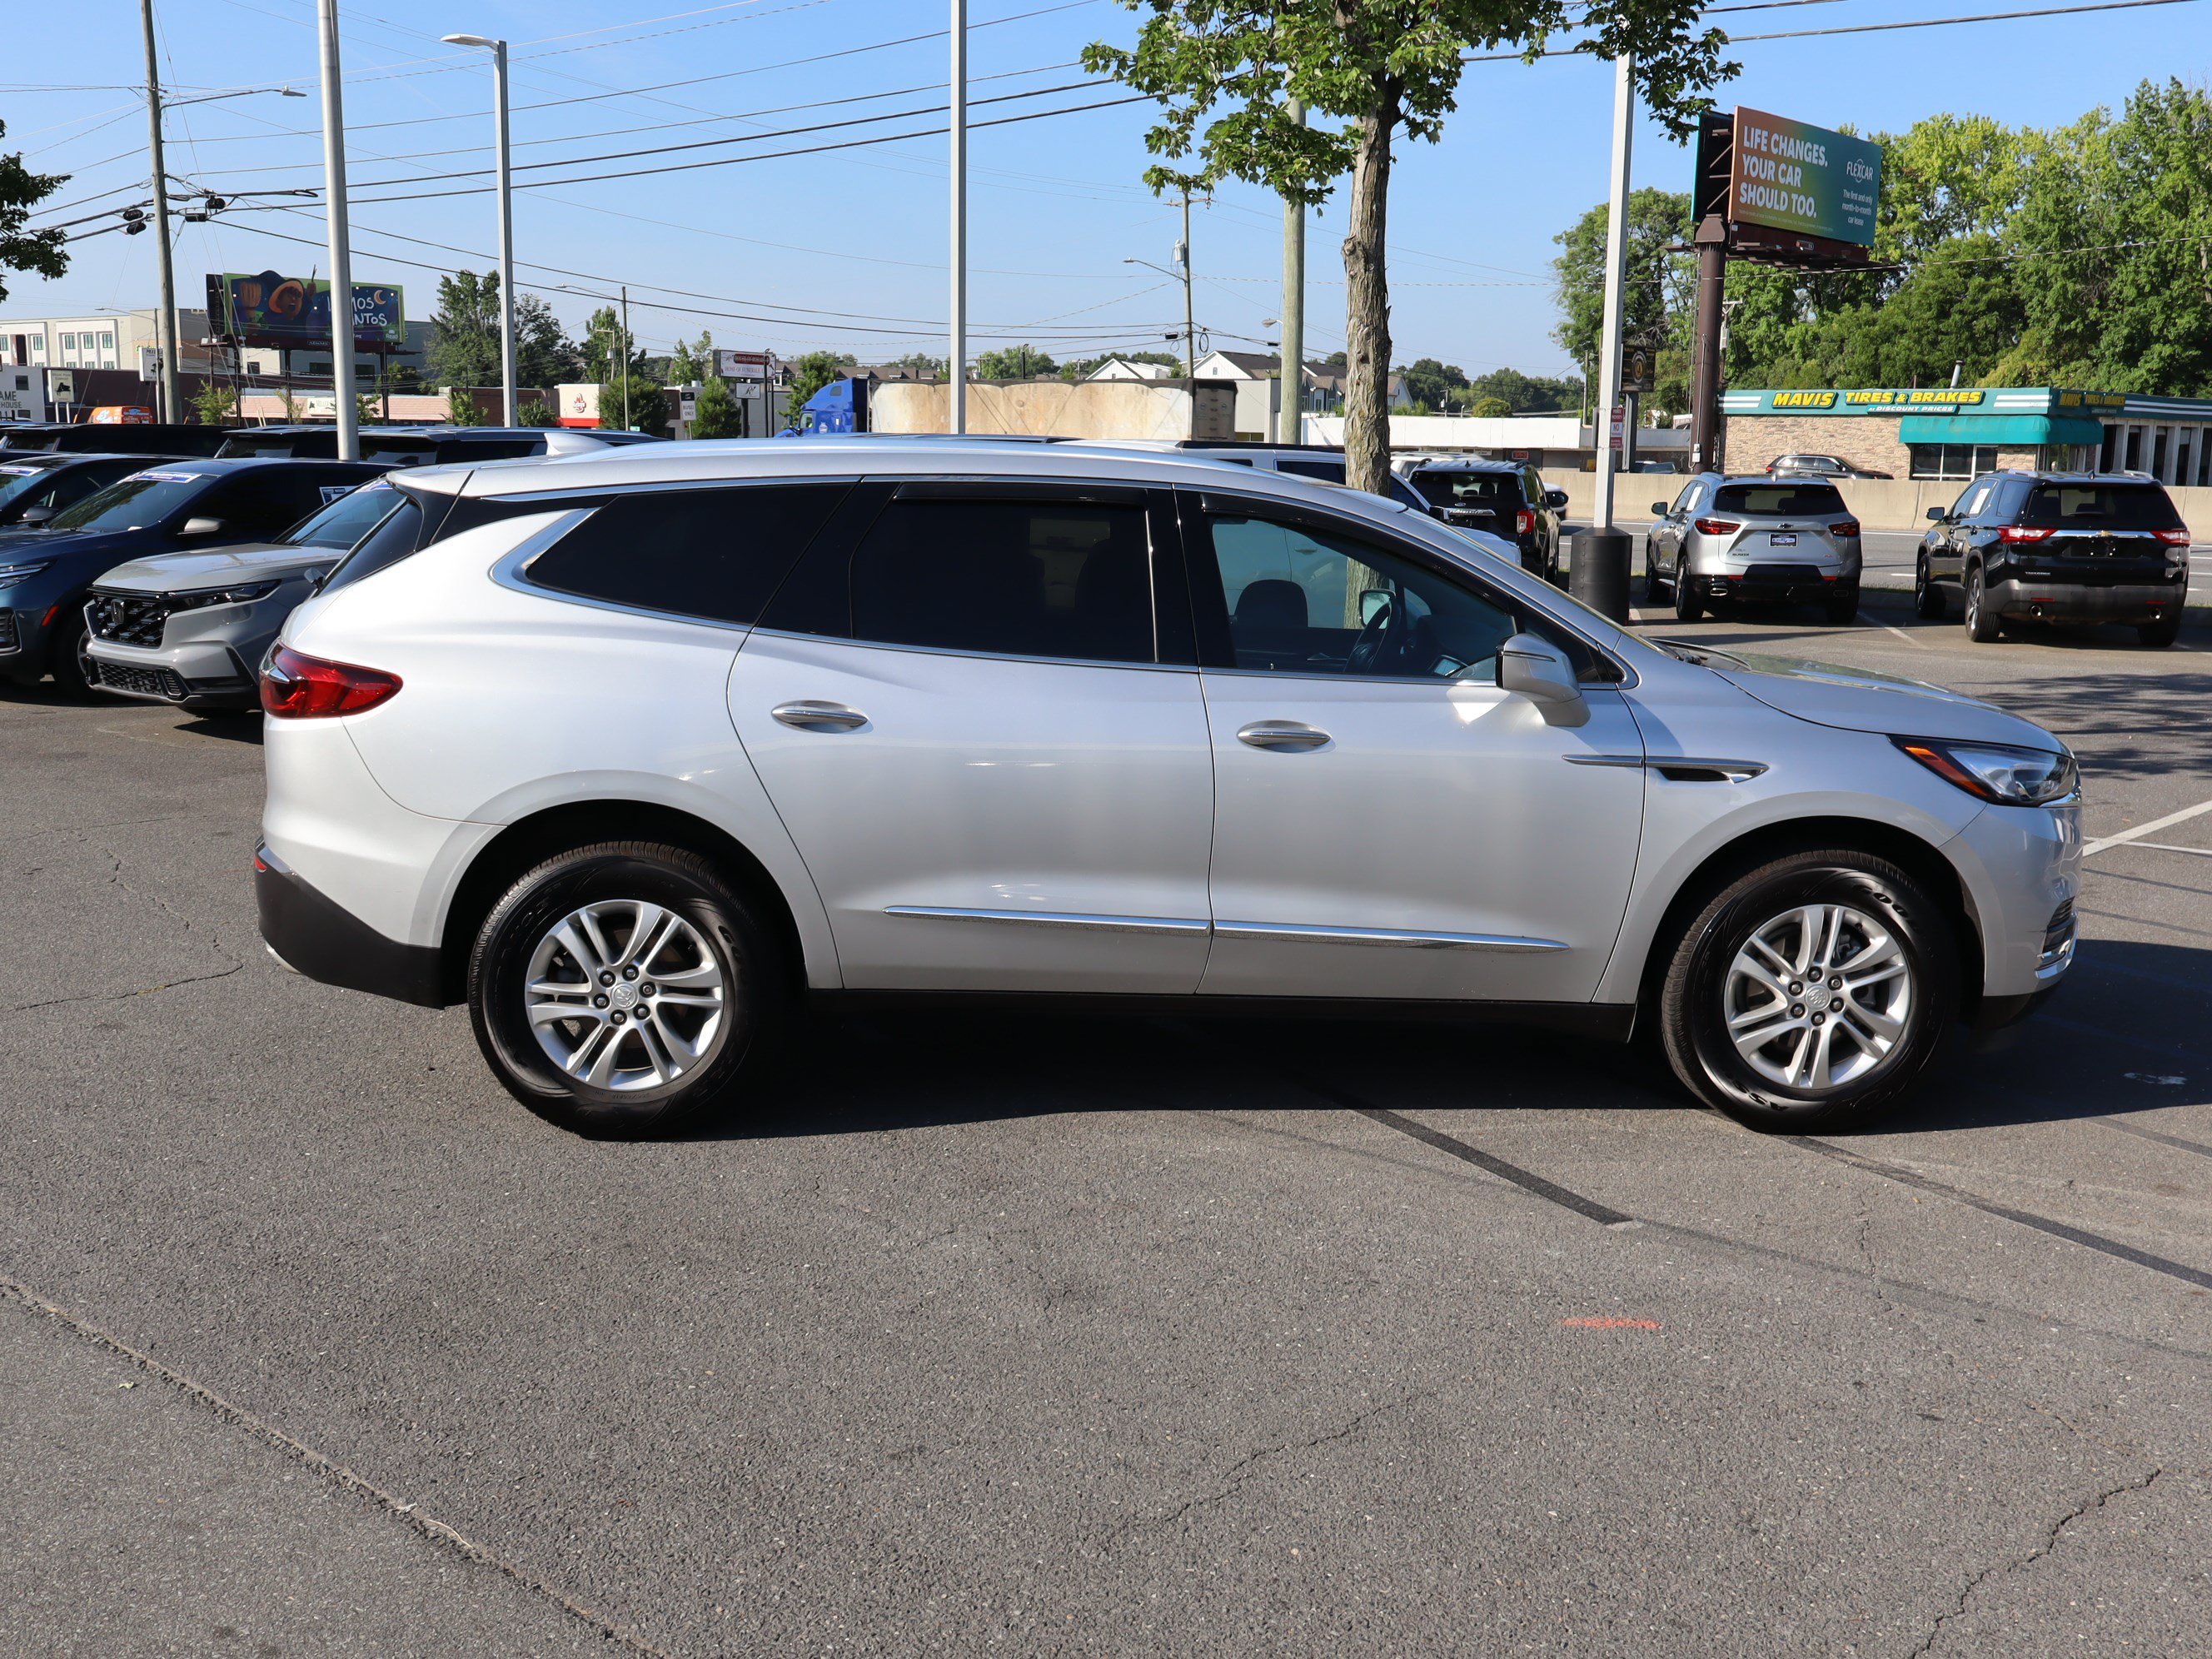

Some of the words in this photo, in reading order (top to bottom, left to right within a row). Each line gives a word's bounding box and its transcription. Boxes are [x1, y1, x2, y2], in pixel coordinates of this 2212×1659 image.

[1743, 125, 1768, 150] LIFE
[1771, 132, 1828, 167] CHANGES.
[1741, 153, 1776, 182] YOUR
[1778, 162, 1802, 187] CAR
[1846, 161, 1873, 182] FLEXCAR
[1739, 182, 1789, 212] SHOULD
[1791, 195, 1817, 219] TOO.
[1773, 392, 1835, 406] MAVIS
[1846, 391, 1894, 404] TIRES
[1896, 393, 1906, 404] &
[1910, 391, 1983, 403] BRAKES
